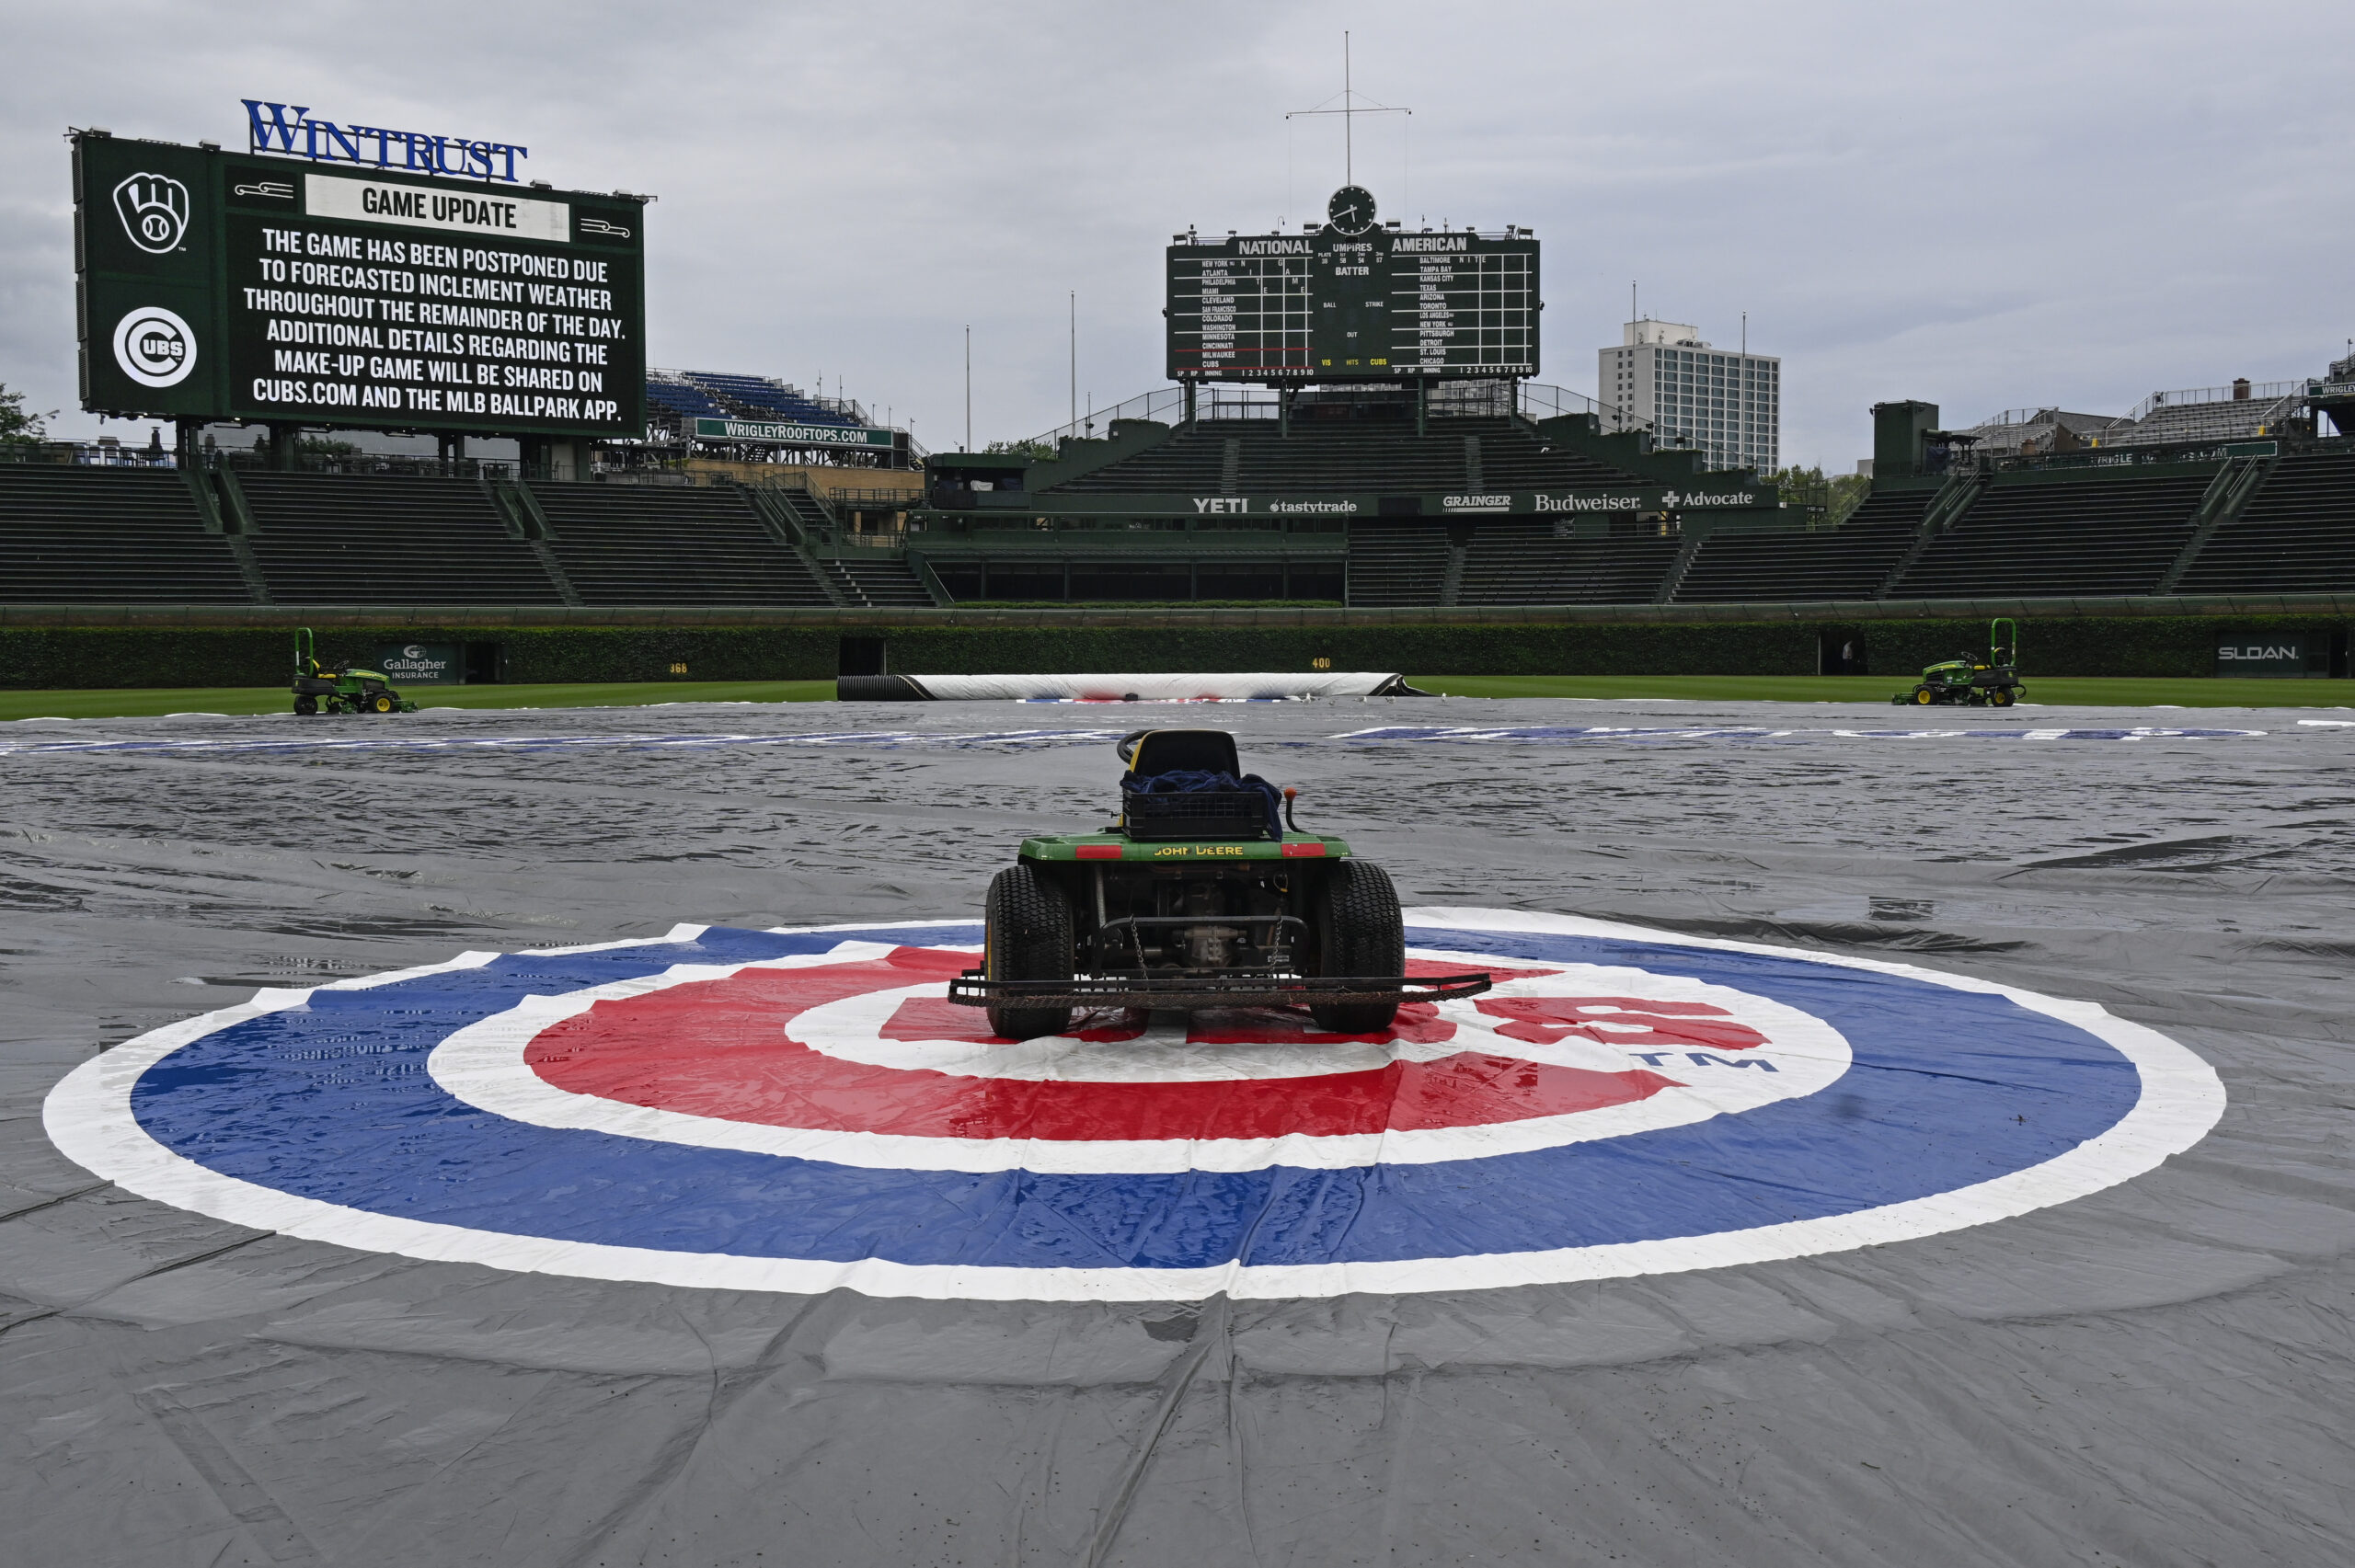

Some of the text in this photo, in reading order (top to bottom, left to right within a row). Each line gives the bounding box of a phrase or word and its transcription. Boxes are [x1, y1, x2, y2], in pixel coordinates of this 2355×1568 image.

[240, 98, 528, 182] WINTRUST
[362, 188, 517, 228] GAME UPDATE
[1239, 240, 1313, 255] NATIONAL
[1333, 243, 1372, 252] UMPIRES
[1391, 237, 1467, 252] AMERICAN
[262, 228, 608, 283] THE GAME HAS BEEN POSTPONED DUE
[1335, 267, 1369, 276] BATTER
[258, 258, 612, 311] TO FORECASTED INCLEMENT WEATHER
[243, 287, 626, 339] THROUGHOUT THE REMAINDER OF THE DAY.
[266, 318, 608, 365] ADDITIONAL DETAILS REGARDING THE
[274, 349, 603, 393] MAKE-UP GAME WILL BE SHARED ON
[253, 378, 622, 421] CUBS.COM AND THE MLB BALLPARK APP.
[724, 422, 867, 443] WRIGLEYROOFTOPS.COM
[1193, 498, 1248, 514] YETI
[1443, 495, 1511, 507] GRAINGER
[1683, 491, 1753, 506] Advocate
[1281, 500, 1357, 513] tastytrade
[383, 659, 447, 671] Gallagher
[670, 663, 687, 673] 368
[1312, 658, 1330, 668] 400
[1195, 846, 1244, 855] DEERE
[1628, 1052, 1780, 1073] TM
